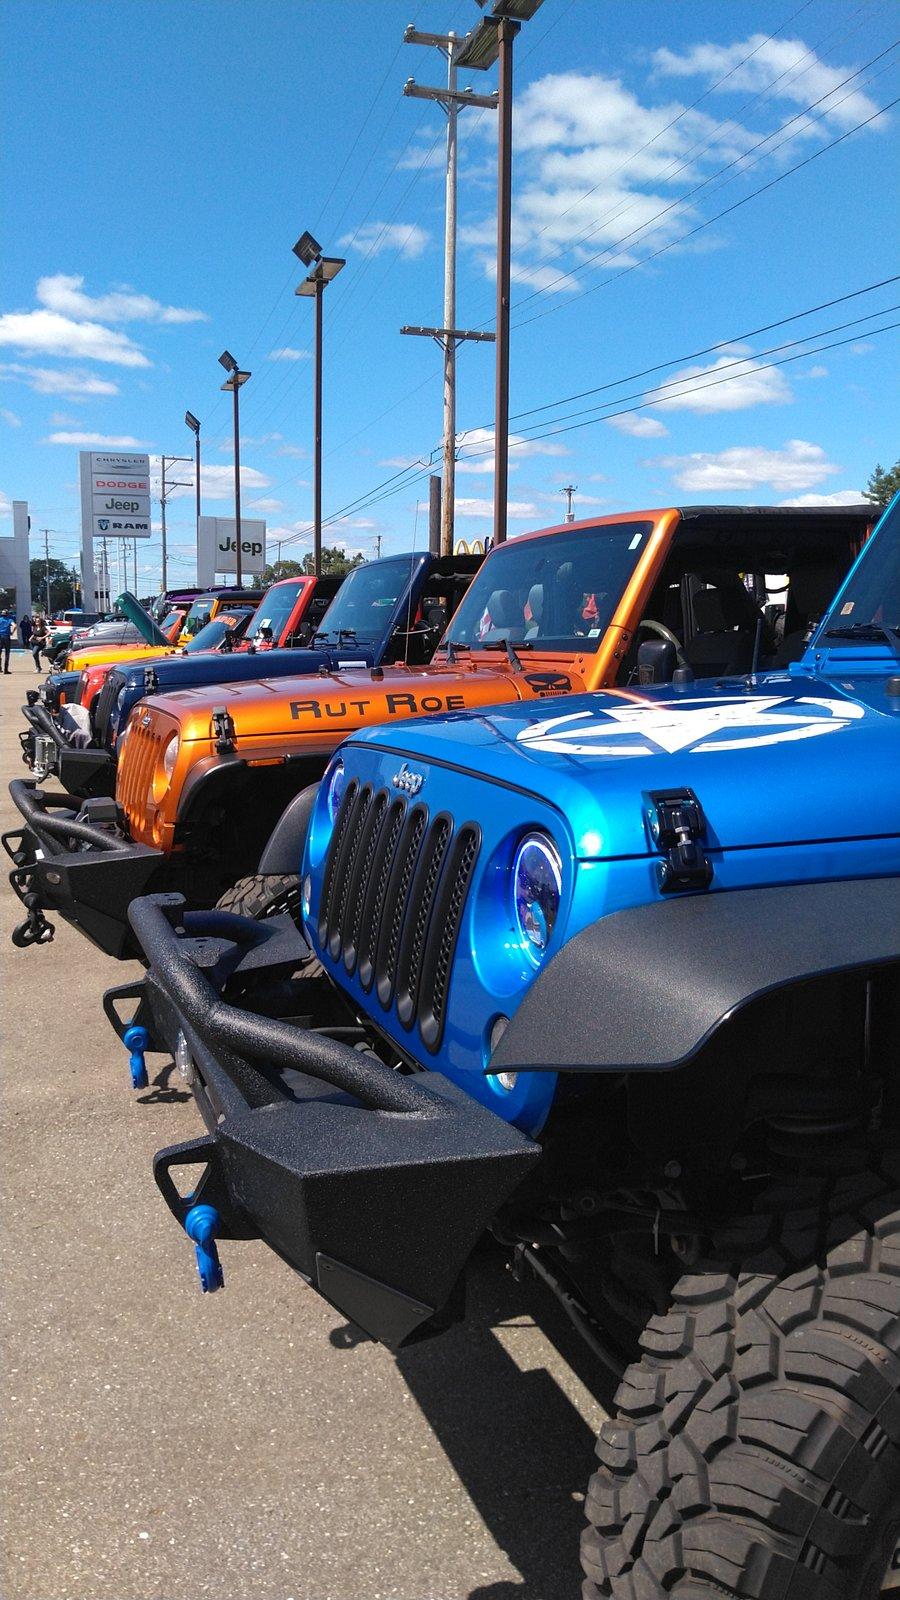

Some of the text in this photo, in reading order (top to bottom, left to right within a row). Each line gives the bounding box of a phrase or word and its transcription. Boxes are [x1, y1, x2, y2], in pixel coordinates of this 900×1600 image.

[96, 456, 145, 464] CHRYSLER
[96, 480, 147, 489] DODGE
[105, 498, 139, 512] Jeep
[112, 522, 148, 530] RAM
[218, 536, 263, 556] Jeep
[392, 762, 423, 799] Jeep
